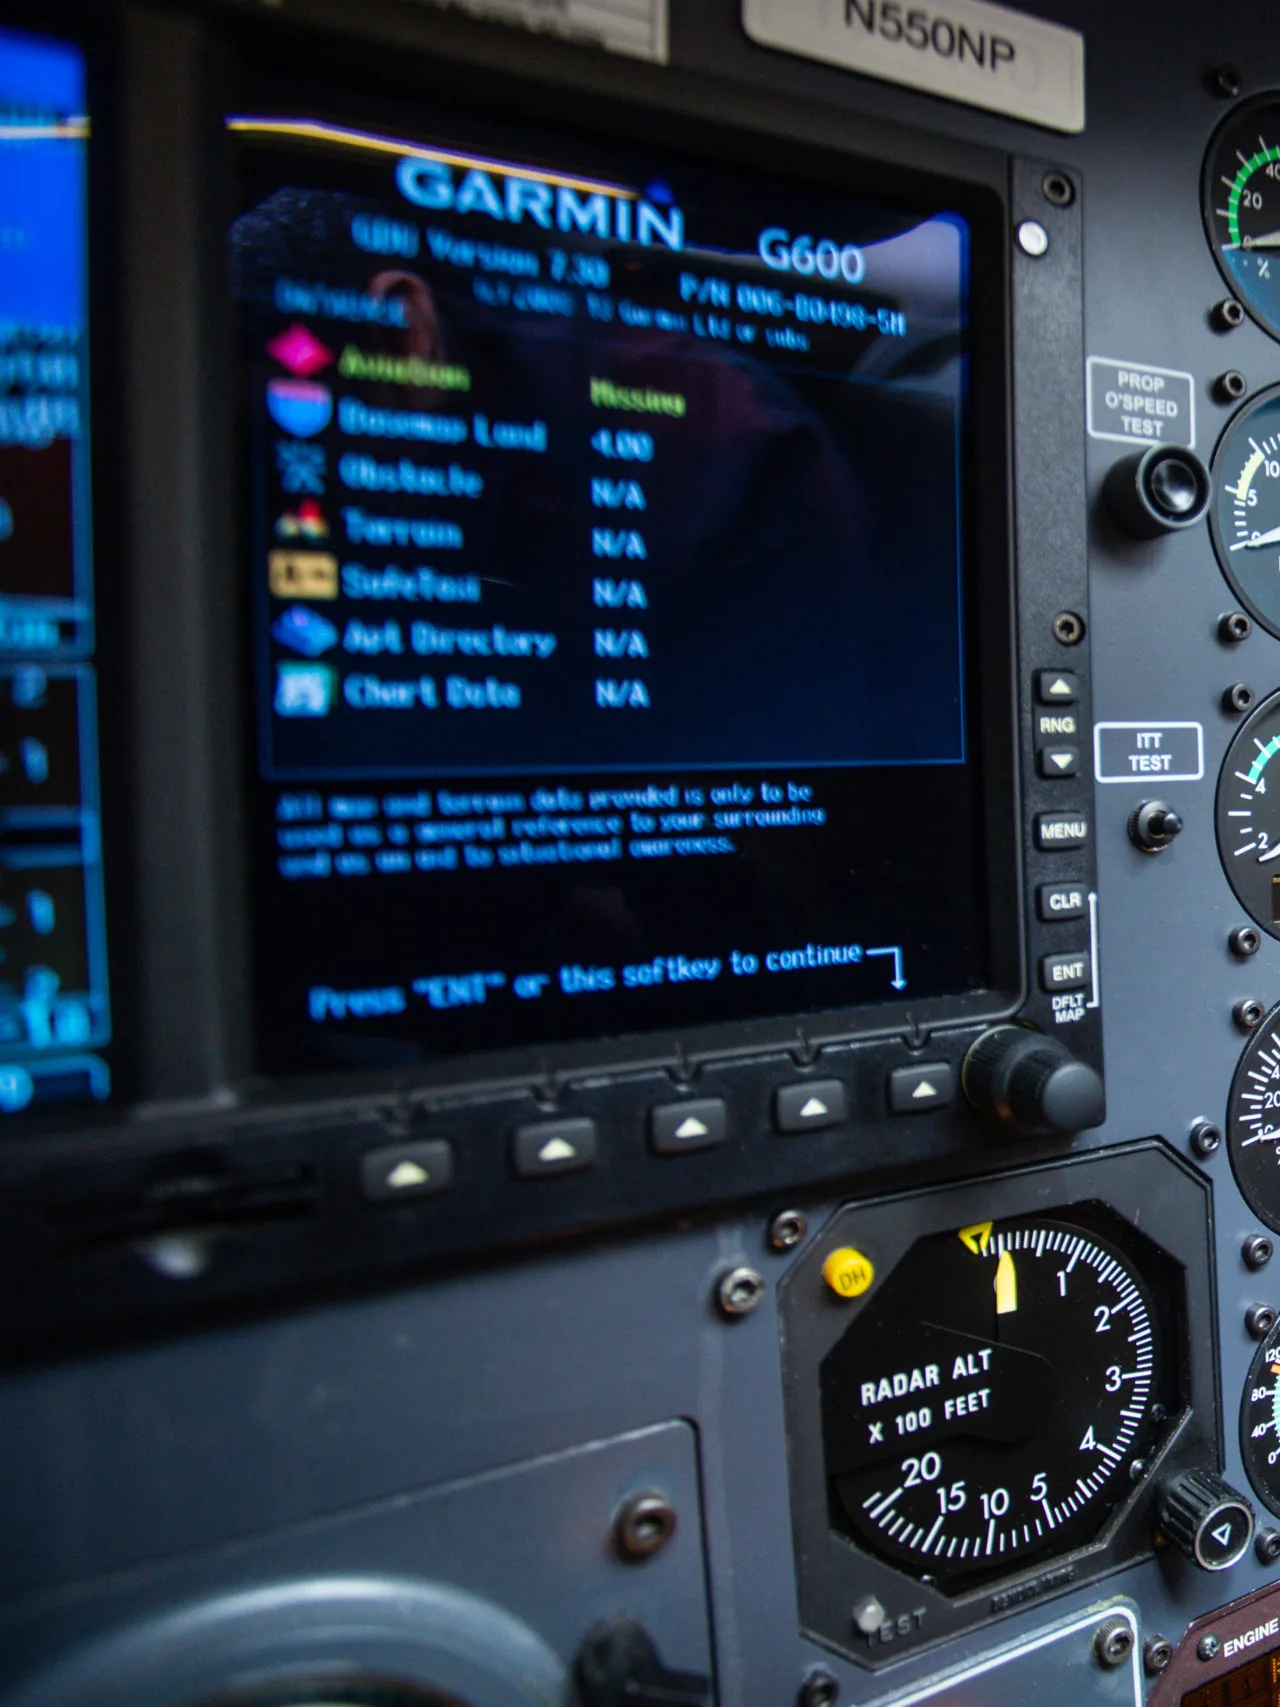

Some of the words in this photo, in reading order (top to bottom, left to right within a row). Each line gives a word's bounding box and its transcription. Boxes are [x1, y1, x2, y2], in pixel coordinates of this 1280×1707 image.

[844, 0, 1016, 72] N550NP
[395, 156, 685, 251] GARMIN
[1243, 191, 1262, 209] 20
[758, 227, 865, 283] G600
[1257, 259, 1270, 279] %
[1119, 371, 1164, 391] PROP
[1106, 392, 1177, 418] O'SPEED
[1121, 416, 1163, 437] TEST
[1264, 461, 1280, 477] 10
[591, 478, 645, 511] N/A
[1248, 490, 1257, 506] 5
[592, 529, 646, 561] N/A
[593, 578, 648, 609] N/A
[594, 628, 649, 659] N/A
[596, 679, 650, 708] N/A
[1040, 716, 1076, 733] RNG
[1136, 733, 1161, 748] ITT
[1129, 755, 1171, 772] TEST
[1255, 779, 1265, 794] 4
[1041, 822, 1086, 839] MENU
[1258, 833, 1268, 849] 2
[1050, 892, 1082, 910] CLR
[561, 964, 615, 992] this
[623, 951, 722, 989] softkey
[730, 949, 758, 975] to
[766, 941, 862, 969] continue
[1053, 962, 1084, 981] ENT
[1052, 993, 1085, 1010] DFLT
[1055, 1008, 1085, 1023] MAP
[838, 1267, 866, 1292] DH
[1057, 1271, 1066, 1296] 1
[1094, 1306, 1110, 1332] 2
[860, 1365, 940, 1407] RADAR
[953, 1349, 992, 1381] ALT
[1105, 1367, 1121, 1392] 3
[1252, 1387, 1266, 1401] 80
[869, 1423, 883, 1444] X
[895, 1408, 932, 1437] 100
[945, 1388, 991, 1420] FEET
[1079, 1425, 1096, 1451] 4
[1252, 1425, 1267, 1438] 40
[901, 1452, 941, 1488] 20
[1268, 1453, 1276, 1464] 0
[937, 1481, 967, 1513] 15
[1031, 1473, 1047, 1500] 5
[981, 1489, 1009, 1519] 10
[1223, 1619, 1280, 1658] ENGINE
